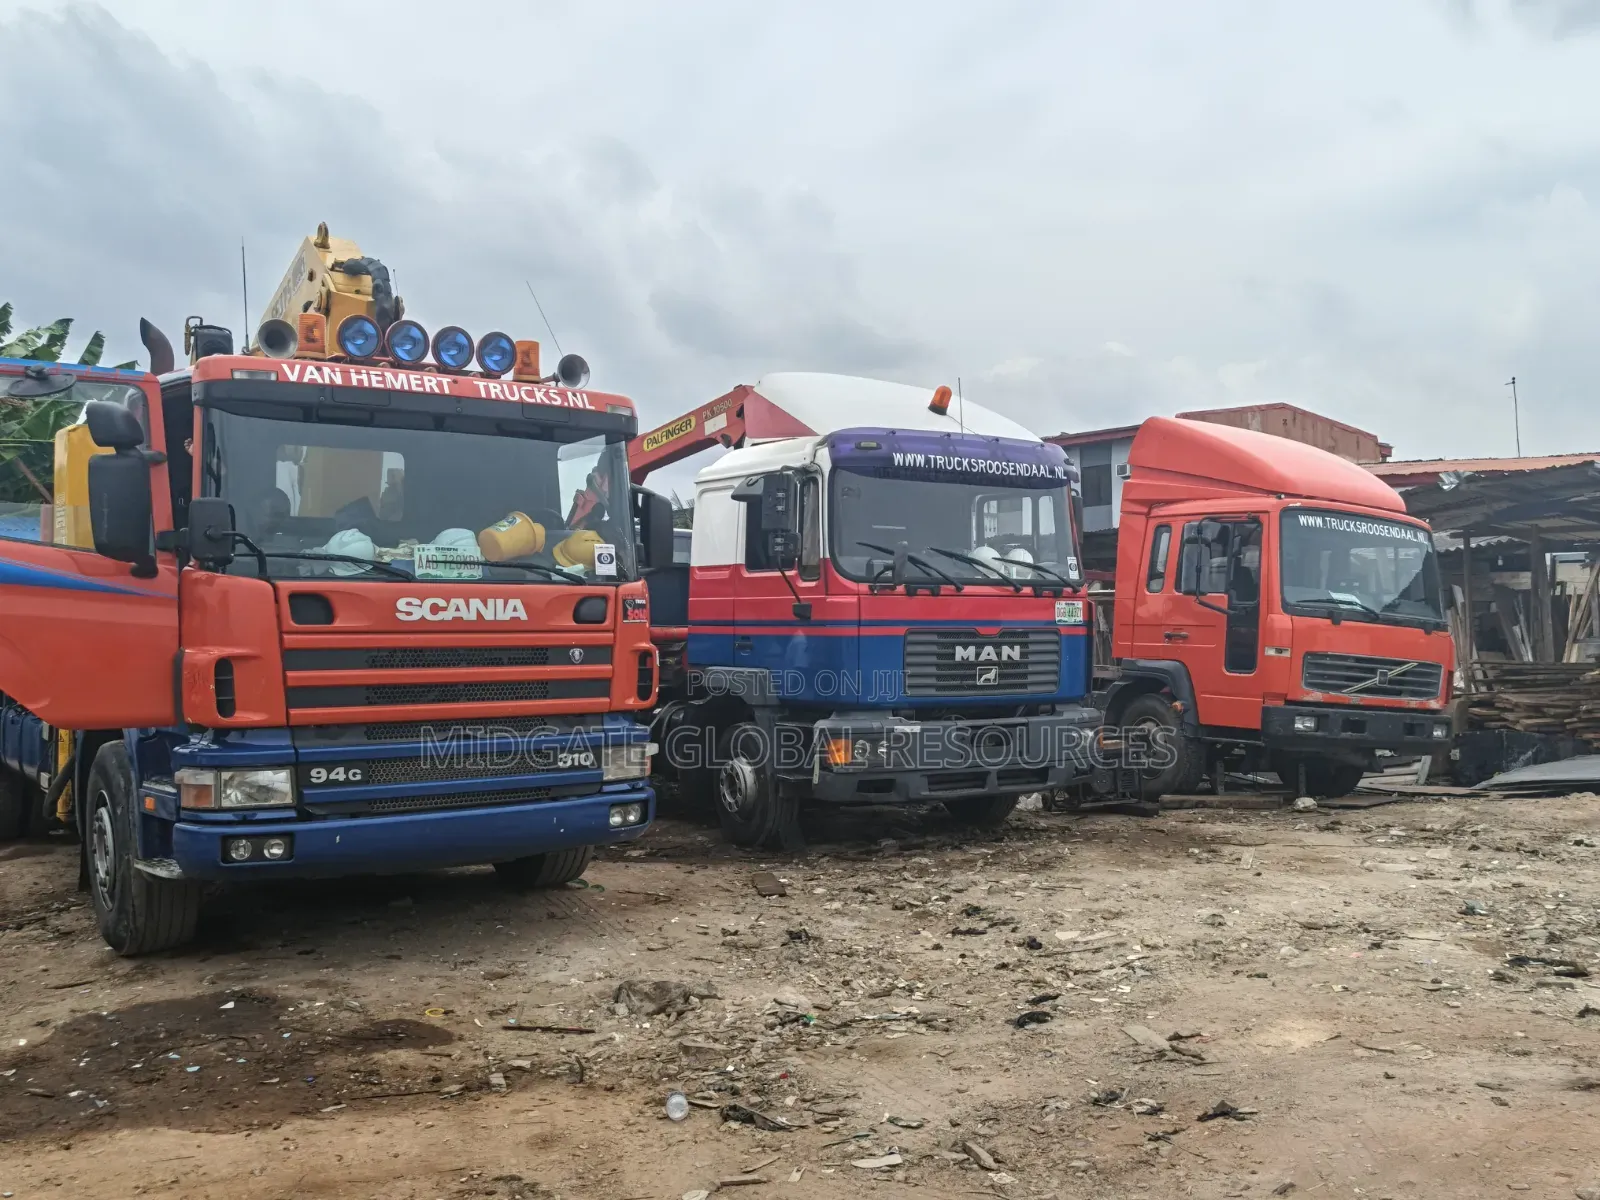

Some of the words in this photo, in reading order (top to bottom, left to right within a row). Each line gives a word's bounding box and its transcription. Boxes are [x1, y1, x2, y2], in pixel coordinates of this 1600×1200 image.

[282, 364, 342, 385] VAN
[350, 369, 451, 394] HEMERT
[474, 381, 595, 410] TRUCKS.NL
[702, 409, 713, 420] PK
[646, 418, 692, 449] PALFINGER
[893, 452, 1067, 480] WWW.TRUCKSROOSENDAAL.NL
[1298, 514, 1428, 544] WWW.TRUCKSROOSENDAAL.NL
[395, 597, 528, 621] SCANIA
[955, 645, 1021, 661] MAN
[558, 751, 594, 769] 310
